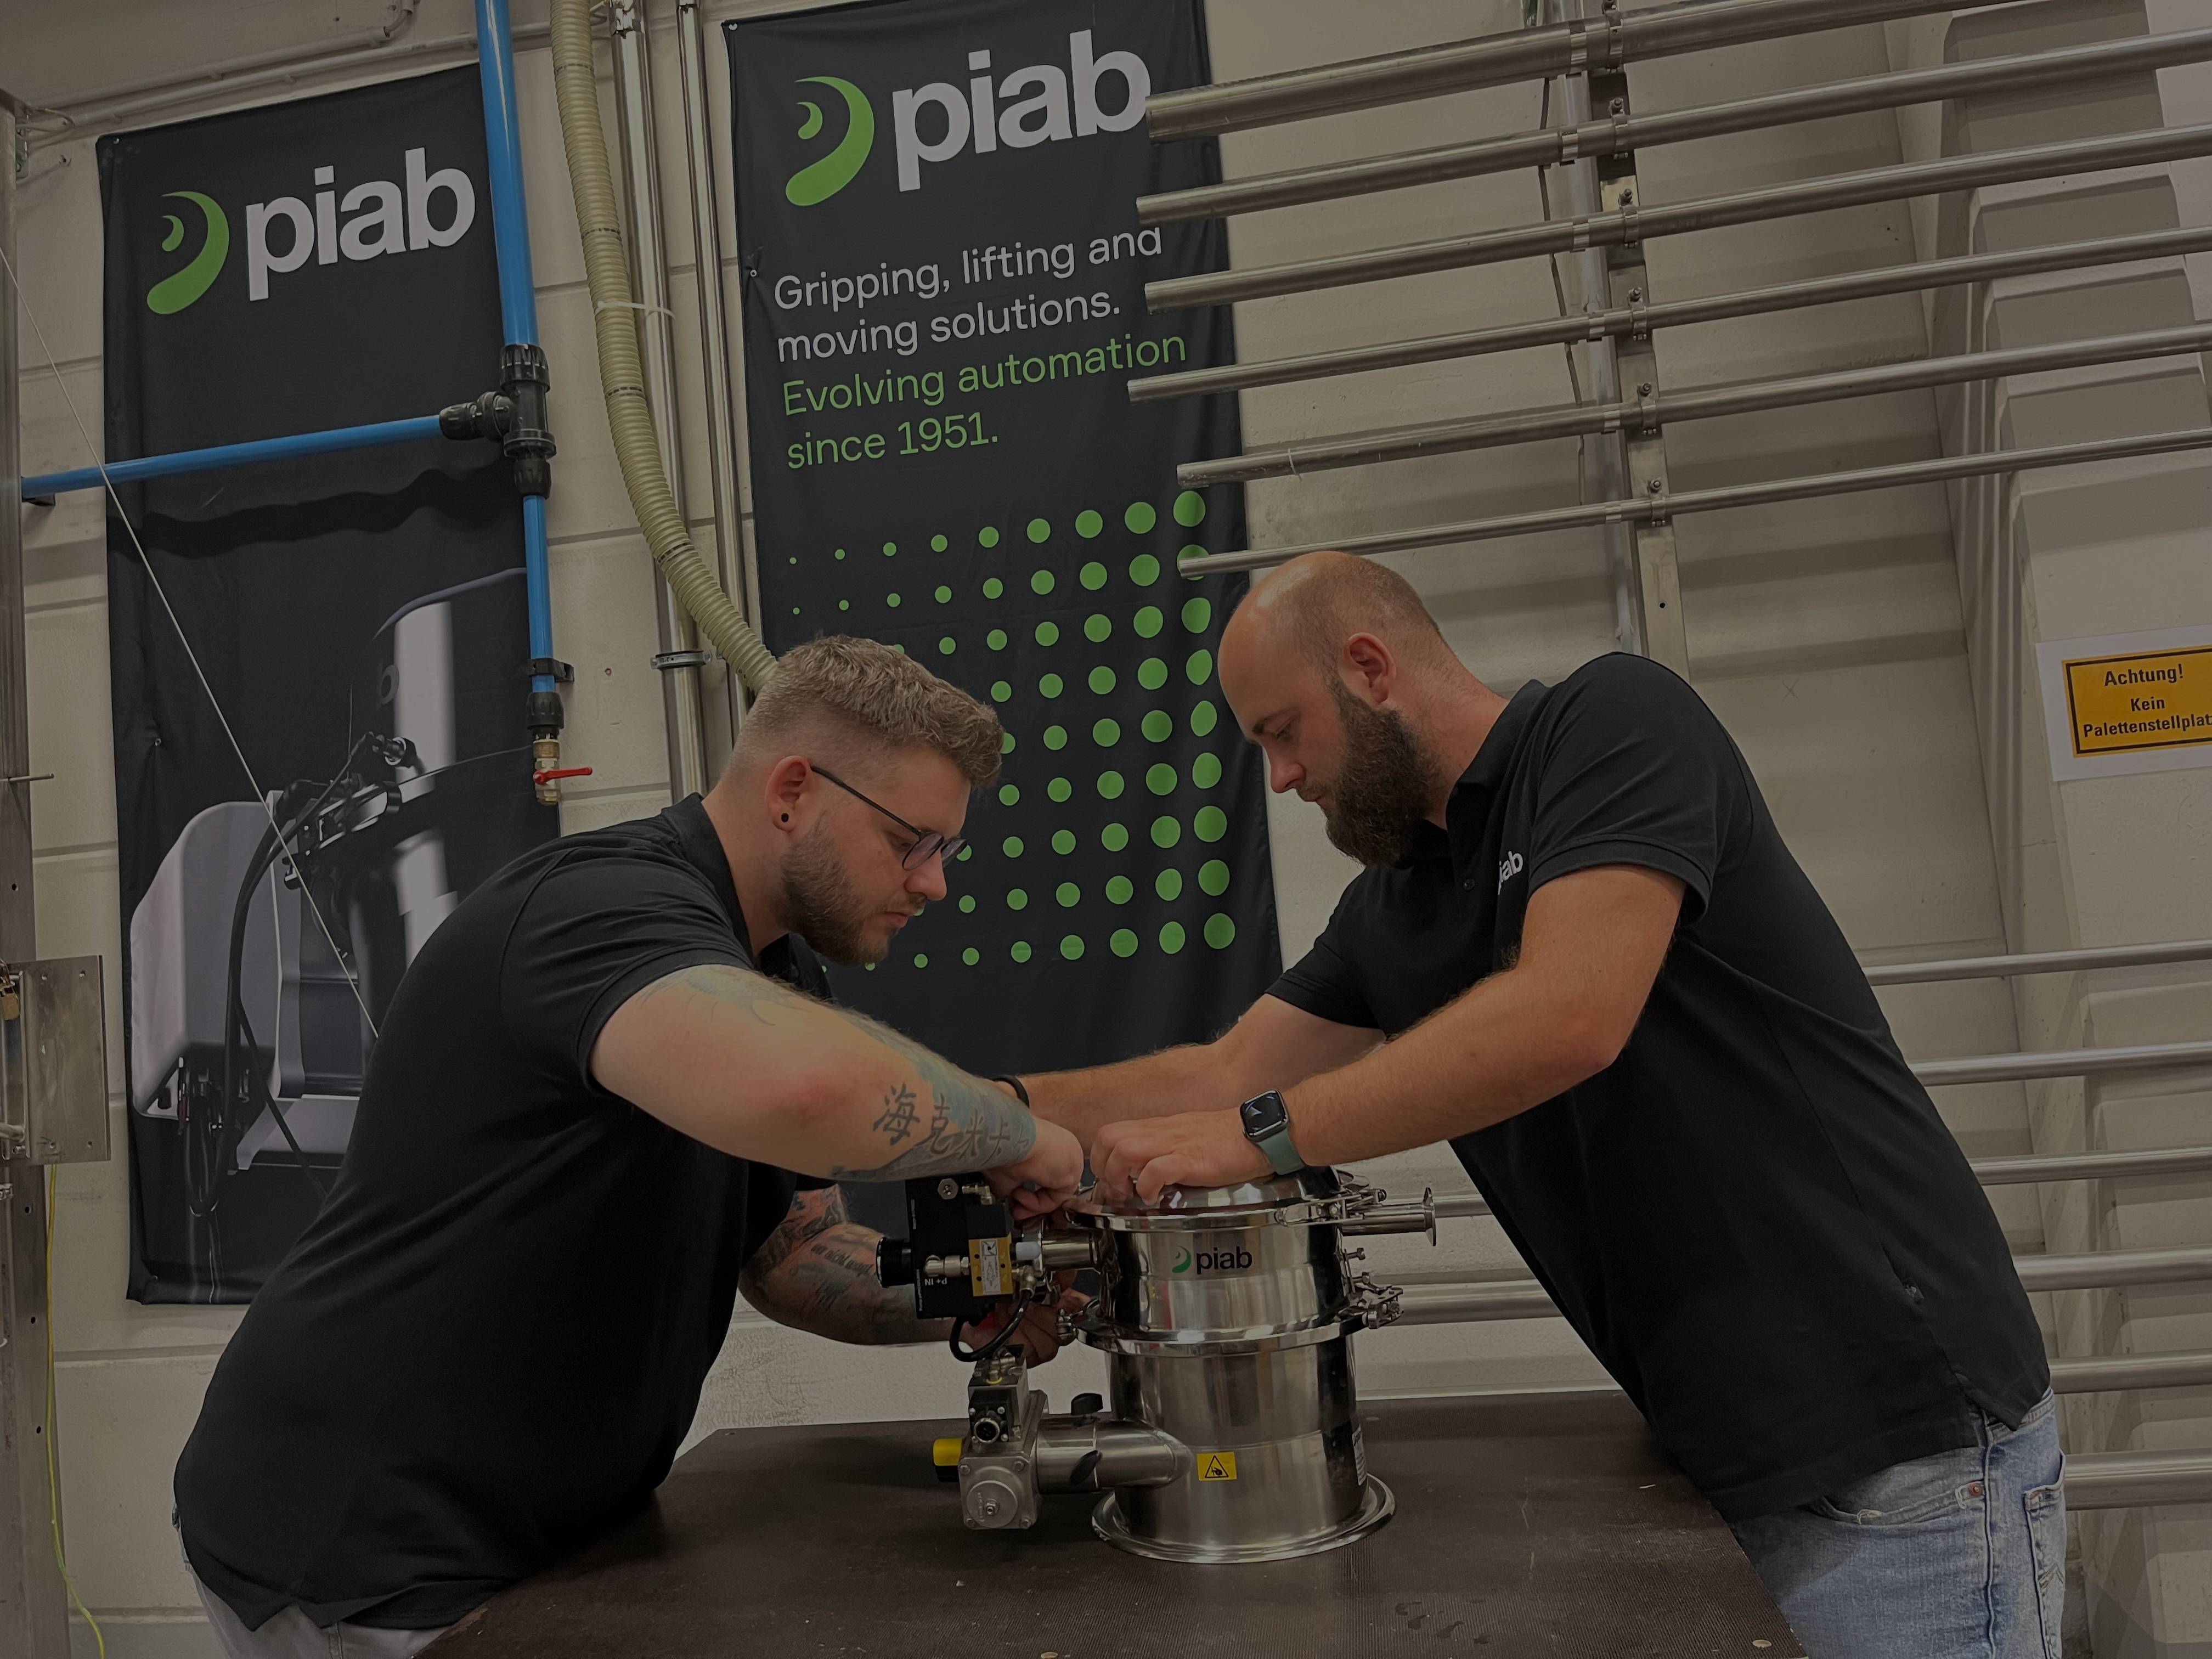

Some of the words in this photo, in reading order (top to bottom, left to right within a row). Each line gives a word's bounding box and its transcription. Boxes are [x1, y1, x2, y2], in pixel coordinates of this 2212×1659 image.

[892, 29, 1151, 192] piab
[246, 147, 476, 301] piab
[775, 262, 950, 312] Gripping,
[962, 242, 1075, 284] lifting
[1088, 227, 1162, 264] and
[778, 319, 918, 363] moving
[930, 292, 1120, 342] solutions.
[783, 369, 945, 416] Evolving
[958, 334, 1187, 392] automation
[788, 431, 885, 469] since
[899, 411, 998, 455] 1951.
[2104, 663, 2183, 686] Achtung!
[2083, 714, 2212, 737] Palettenstellplat
[2130, 696, 2165, 712] Kein
[1498, 850, 1523, 895] iab
[924, 1278, 934, 1286] IN
[1196, 1245, 1252, 1275] piab
